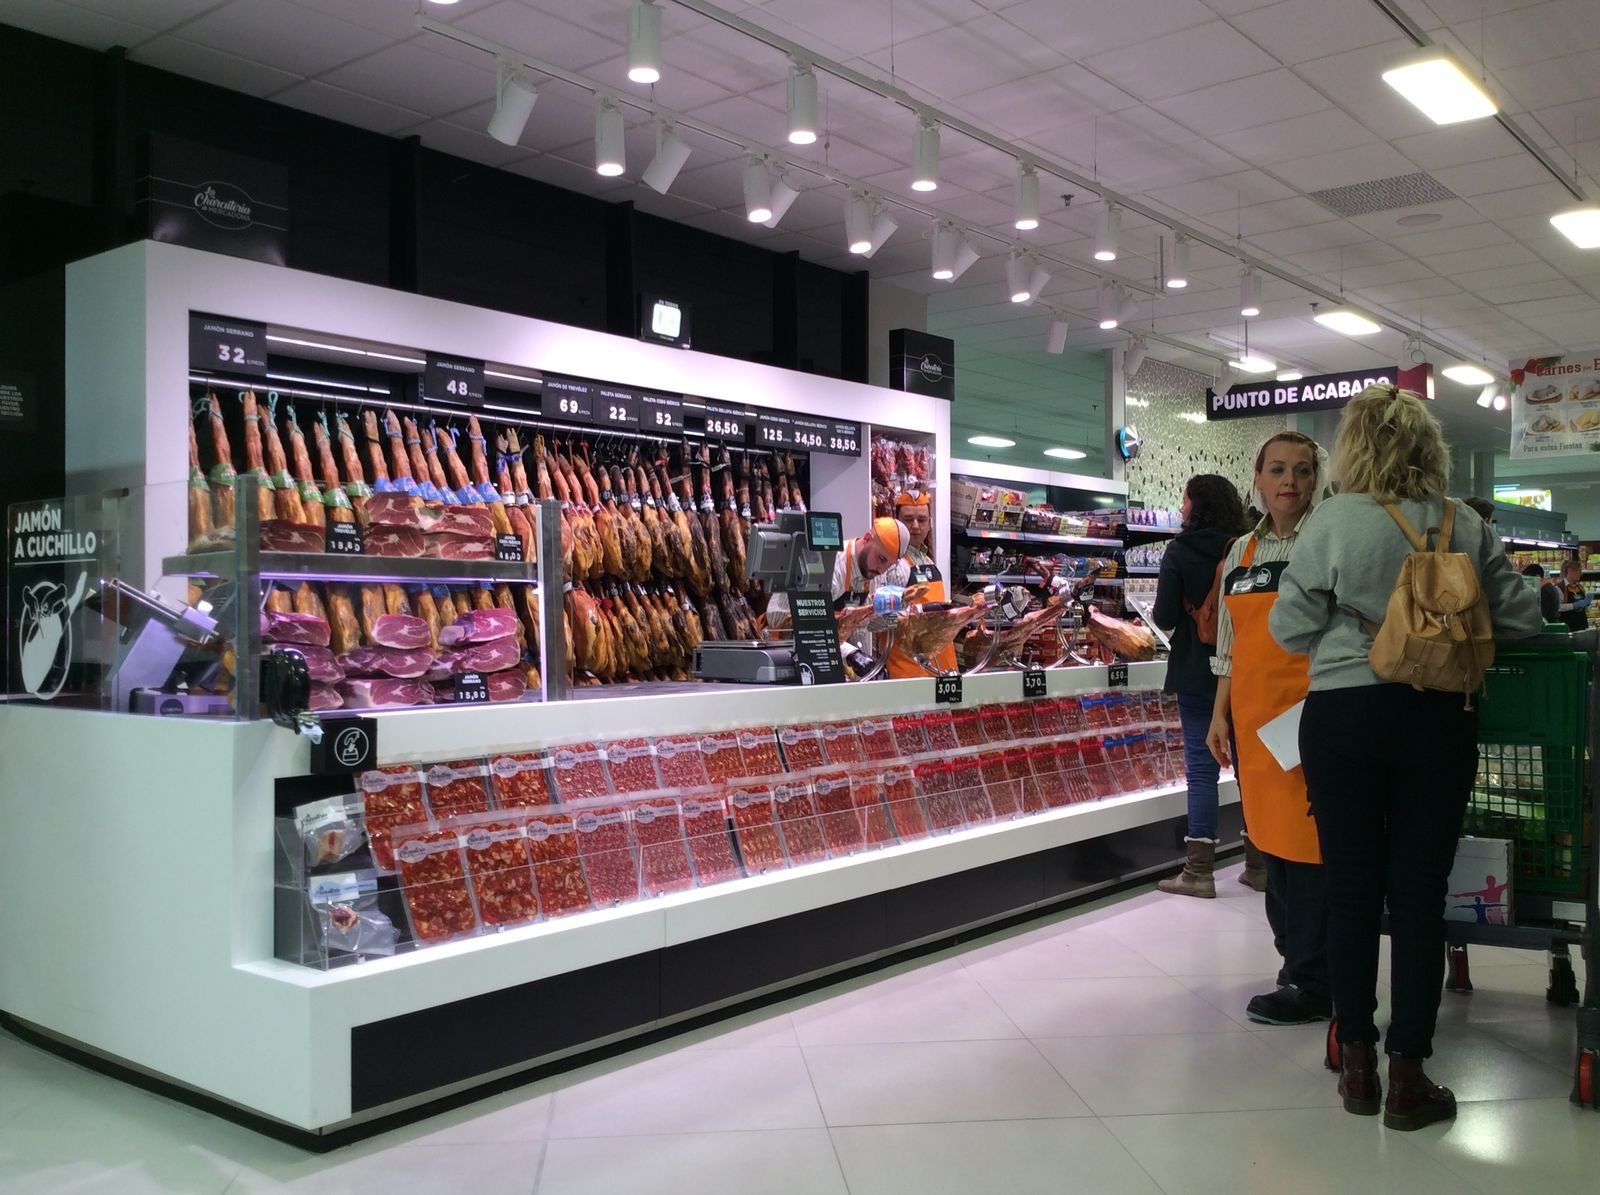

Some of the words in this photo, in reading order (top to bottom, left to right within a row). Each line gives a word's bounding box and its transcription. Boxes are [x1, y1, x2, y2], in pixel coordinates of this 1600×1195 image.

[204, 324, 225, 333] JAMÓN
[226, 327, 254, 338] SERRANO
[218, 344, 245, 364] 32
[436, 361, 453, 369] JAMÓN
[453, 364, 476, 374] SERRANO
[1536, 363, 1582, 377] Carnes
[446, 379, 468, 395] 48
[547, 381, 562, 389] JAMÓN
[568, 384, 588, 393] TREVÉLEZ
[600, 390, 614, 398] PALETA
[559, 398, 579, 414] 69
[1212, 389, 1270, 412] PUNTO
[1275, 386, 1298, 405] DE
[609, 406, 627, 421] 22
[656, 411, 672, 426] 52
[706, 419, 738, 435] 26,50
[763, 427, 783, 442] 125
[794, 431, 822, 447] 34,50
[830, 437, 856, 451] 38,50
[1559, 442, 1583, 450] Fiestas
[15, 503, 61, 533] JAMÓN
[14, 537, 25, 558] A
[27, 531, 97, 557] CUCHILLO
[796, 599, 826, 607] NUESTROS
[798, 608, 827, 616] SERVICIOS
[1025, 677, 1042, 688] 3,70
[1110, 671, 1125, 680] 6,50
[459, 690, 486, 701] 15,80
[938, 683, 957, 695] 3,00
